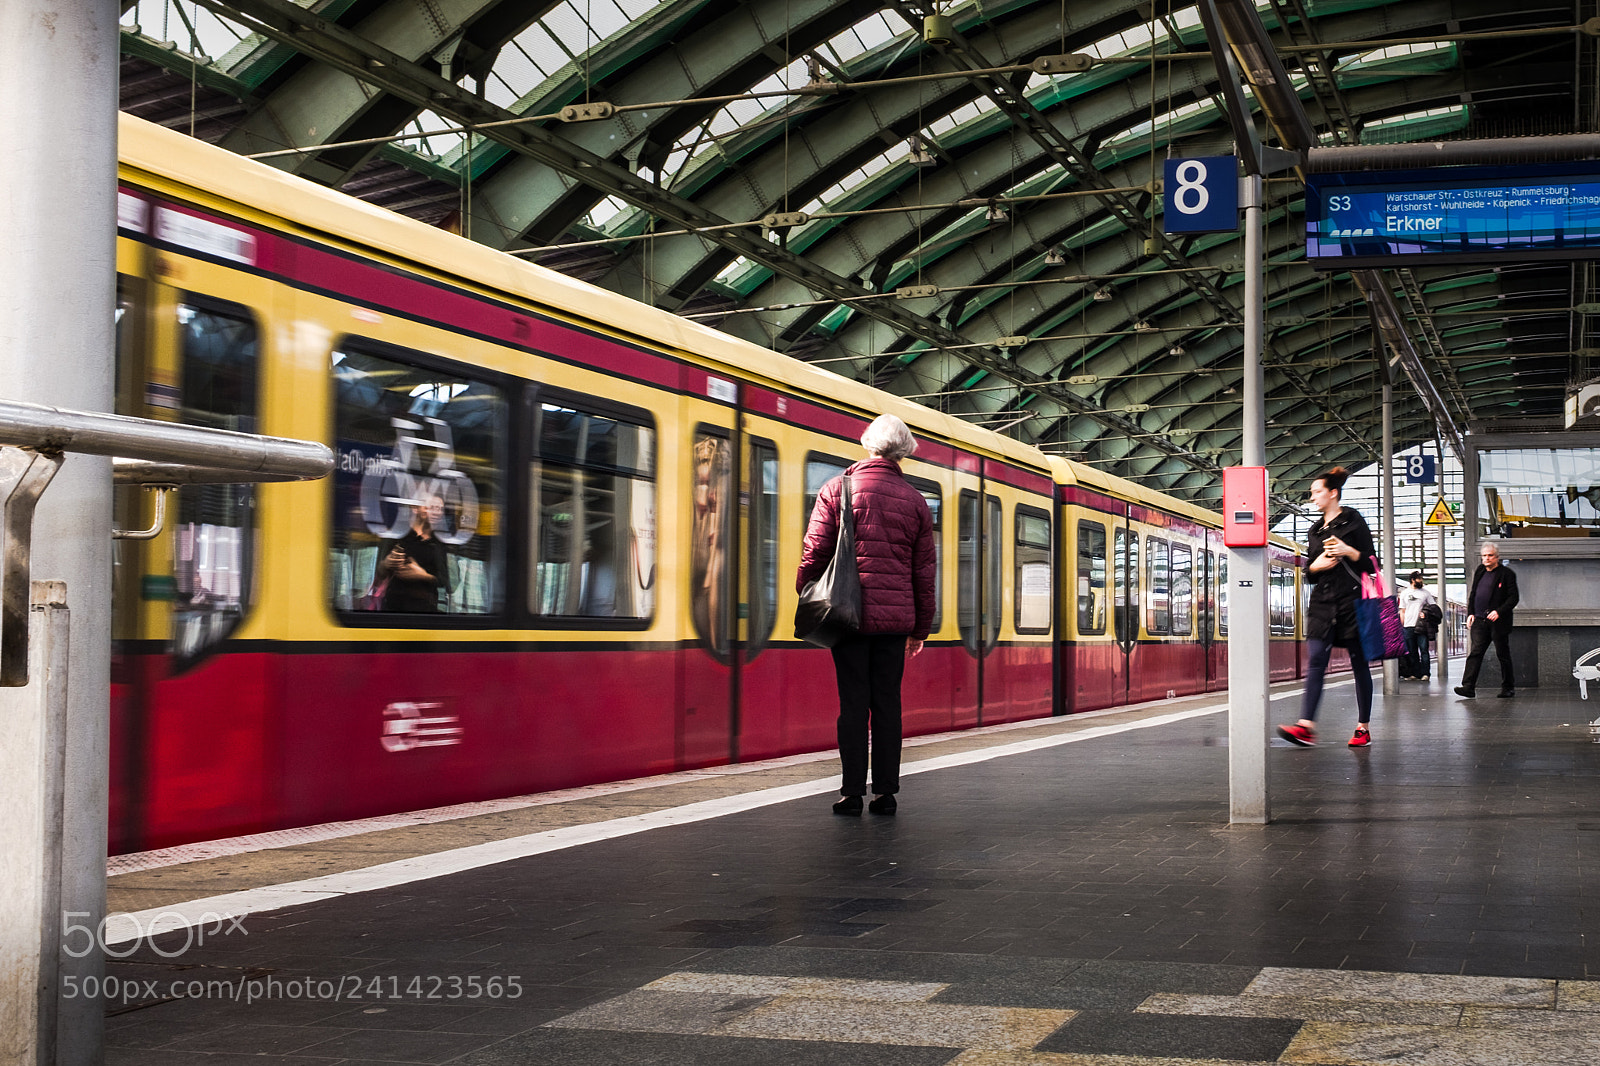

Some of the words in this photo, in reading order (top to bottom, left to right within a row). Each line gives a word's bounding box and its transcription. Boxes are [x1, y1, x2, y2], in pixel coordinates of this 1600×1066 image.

[1174, 160, 1209, 215] 8
[1386, 192, 1437, 202] Warschauer
[1438, 191, 1455, 200] Str.
[1463, 189, 1503, 199] Ostkreuz
[1511, 187, 1569, 196] Rummelsburg
[1329, 196, 1351, 212] S3
[1386, 202, 1432, 212] Karlshorst
[1440, 199, 1485, 209] Wuhlheide
[1540, 196, 1600, 206] Friedrichshag
[1386, 215, 1443, 232] Erkner
[1409, 456, 1424, 477] 8
